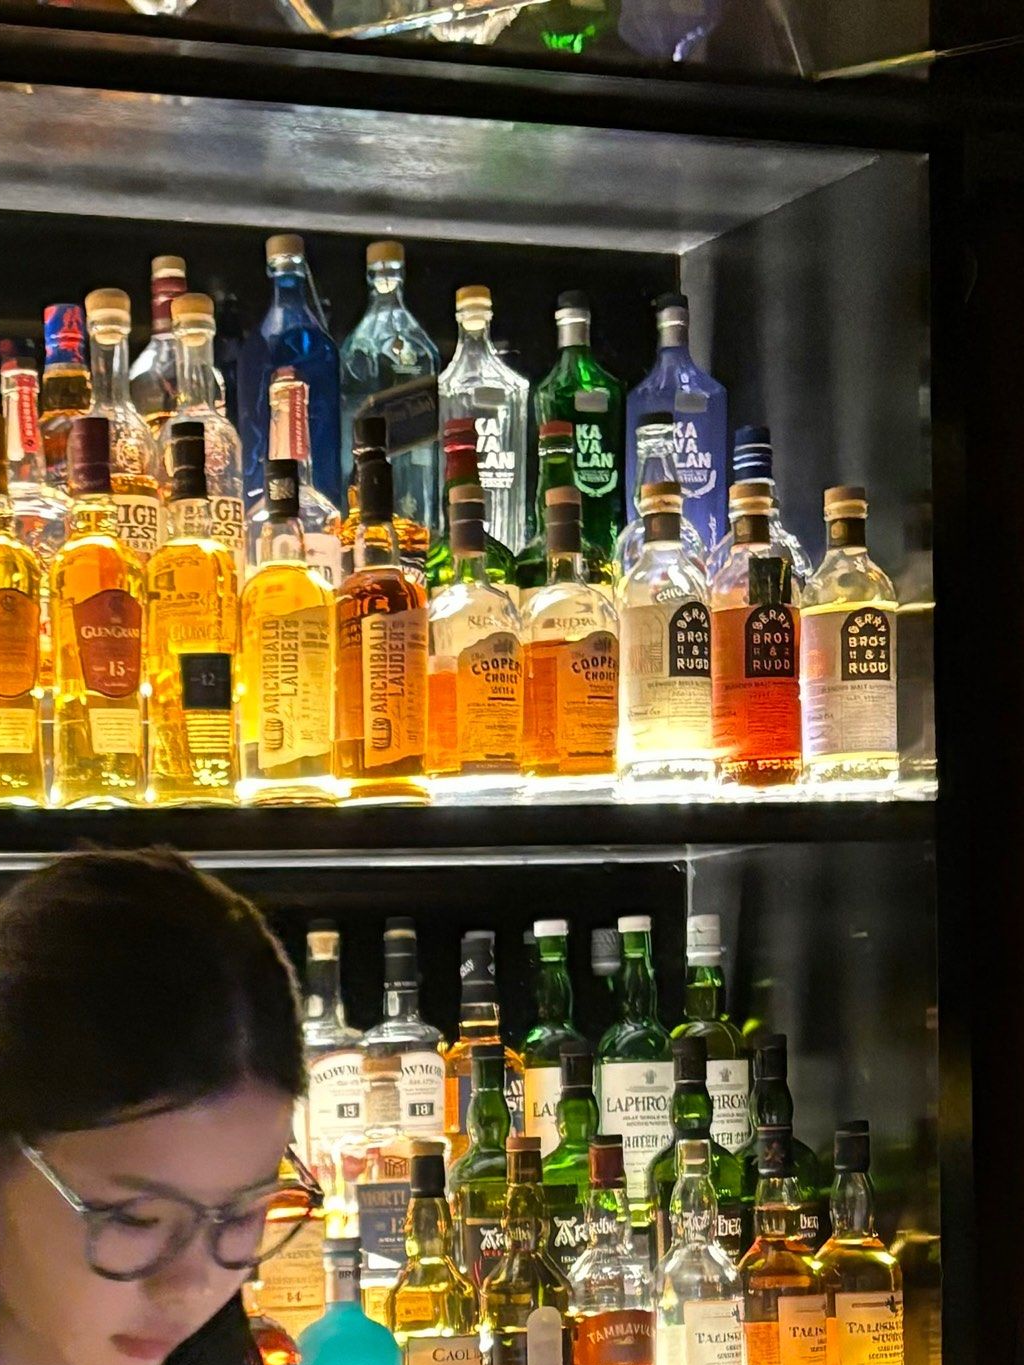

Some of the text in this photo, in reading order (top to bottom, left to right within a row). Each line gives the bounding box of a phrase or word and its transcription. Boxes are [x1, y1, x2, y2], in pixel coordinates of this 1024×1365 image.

[576, 424, 602, 440] KA
[577, 440, 602, 454] VA
[577, 452, 614, 468] LAN
[675, 452, 712, 468] LAN
[676, 608, 708, 629] BERRY
[752, 608, 791, 630] BERRY
[847, 612, 887, 634] BERRY
[677, 631, 709, 643] BROS
[753, 632, 790, 644] BROS
[848, 636, 886, 648] BROS
[109, 660, 126, 677] 15
[262, 619, 280, 714] ARCHIBALD
[369, 620, 387, 713] ARCHIBALD
[677, 658, 709, 670] RUDD
[753, 660, 791, 671] RUDD
[848, 662, 889, 674] RUDD
[414, 1104, 429, 1115] 18
[432, 1347, 472, 1363] CAOL
